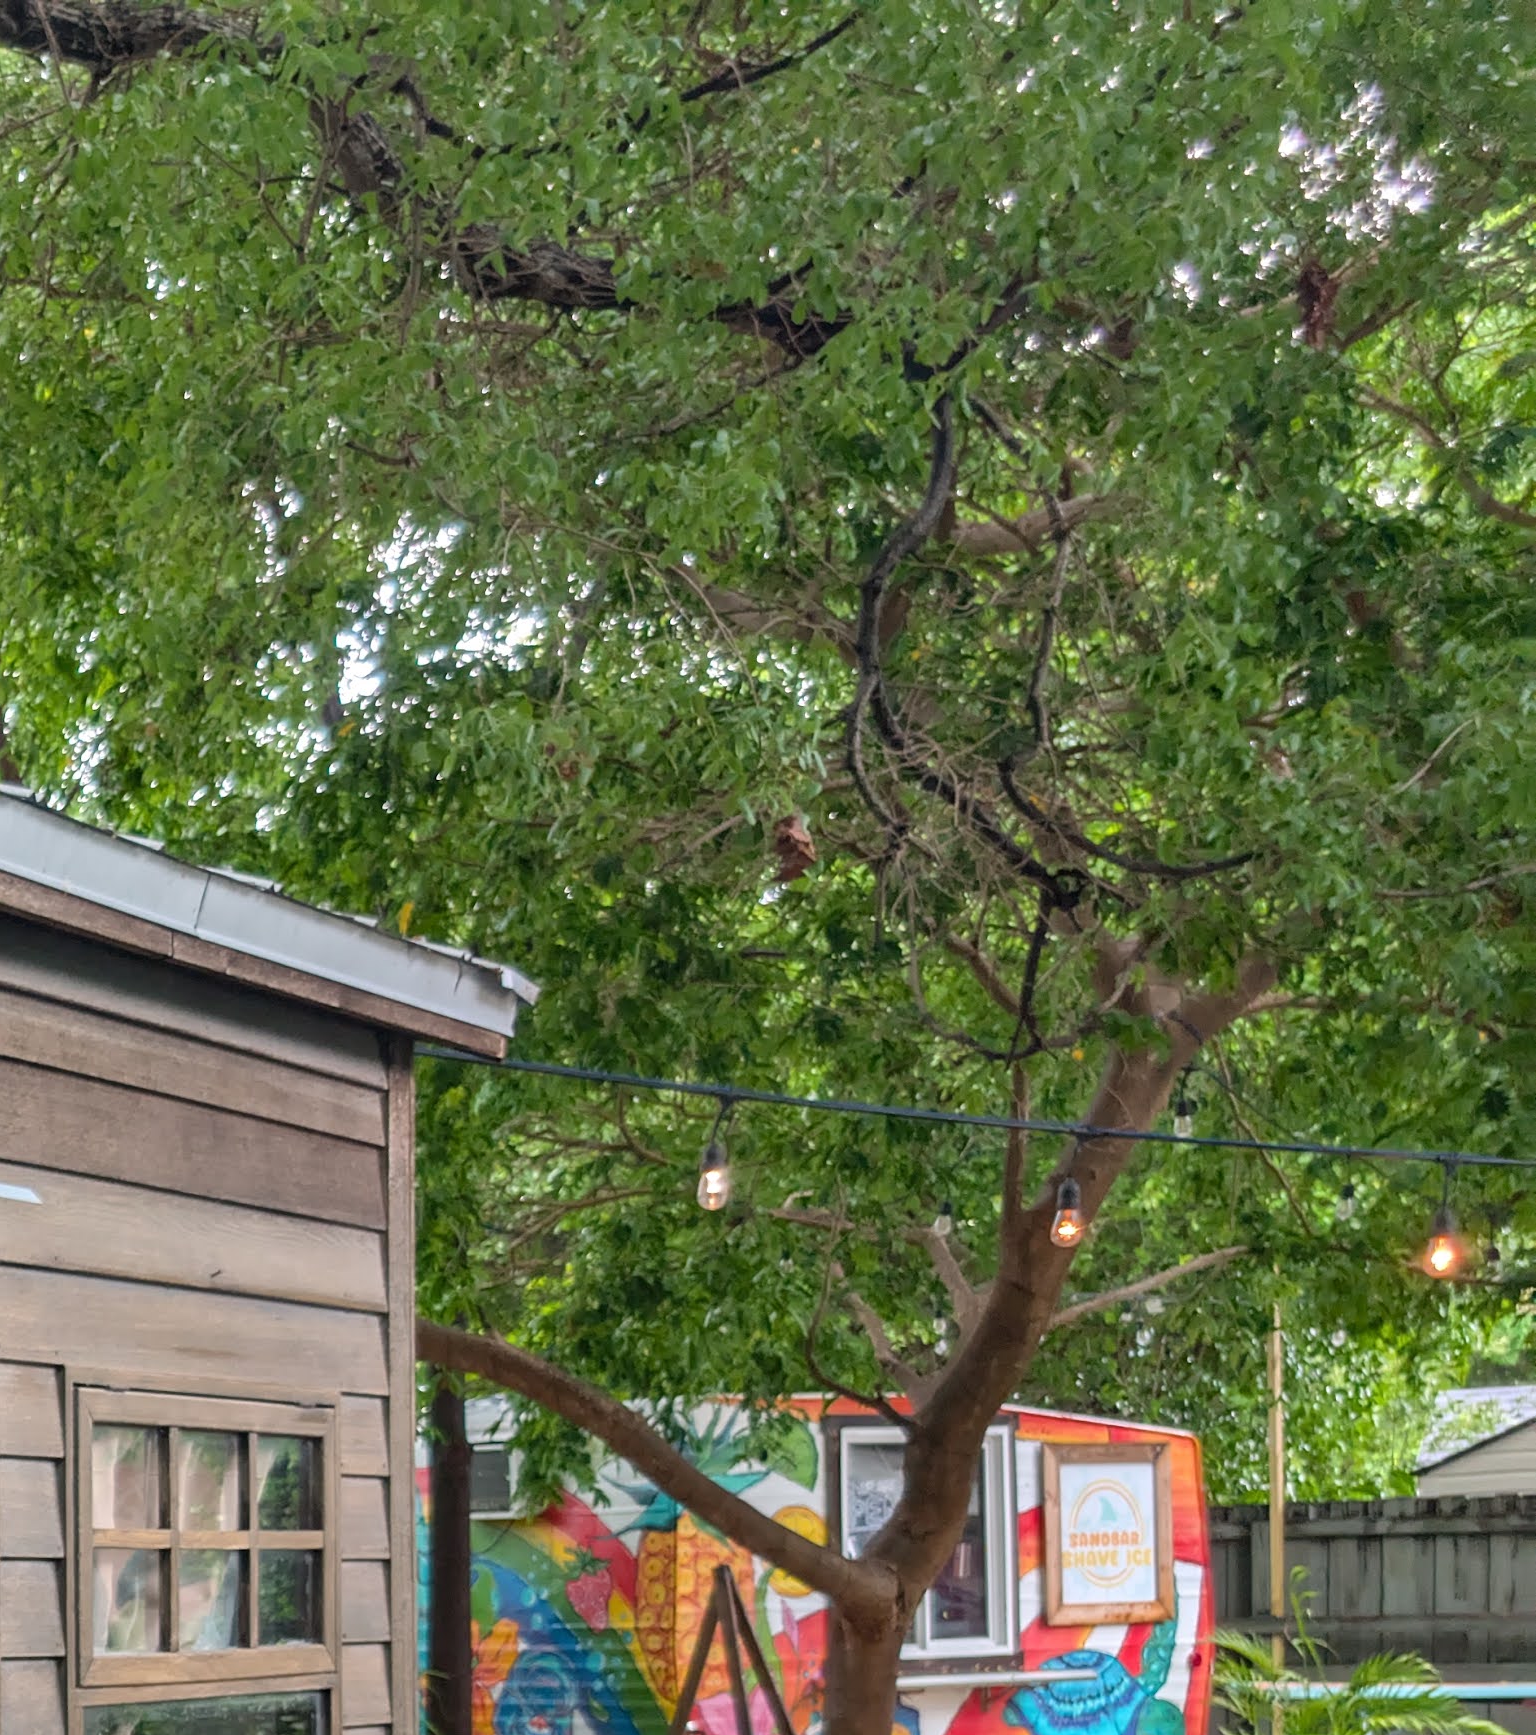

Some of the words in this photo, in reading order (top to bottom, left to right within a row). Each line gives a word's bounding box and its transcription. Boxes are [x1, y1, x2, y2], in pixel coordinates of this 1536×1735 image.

[1070, 1532, 1140, 1548] SANDBAR
[1063, 1551, 1118, 1568] SHAVE
[1127, 1548, 1152, 1566] ICE
